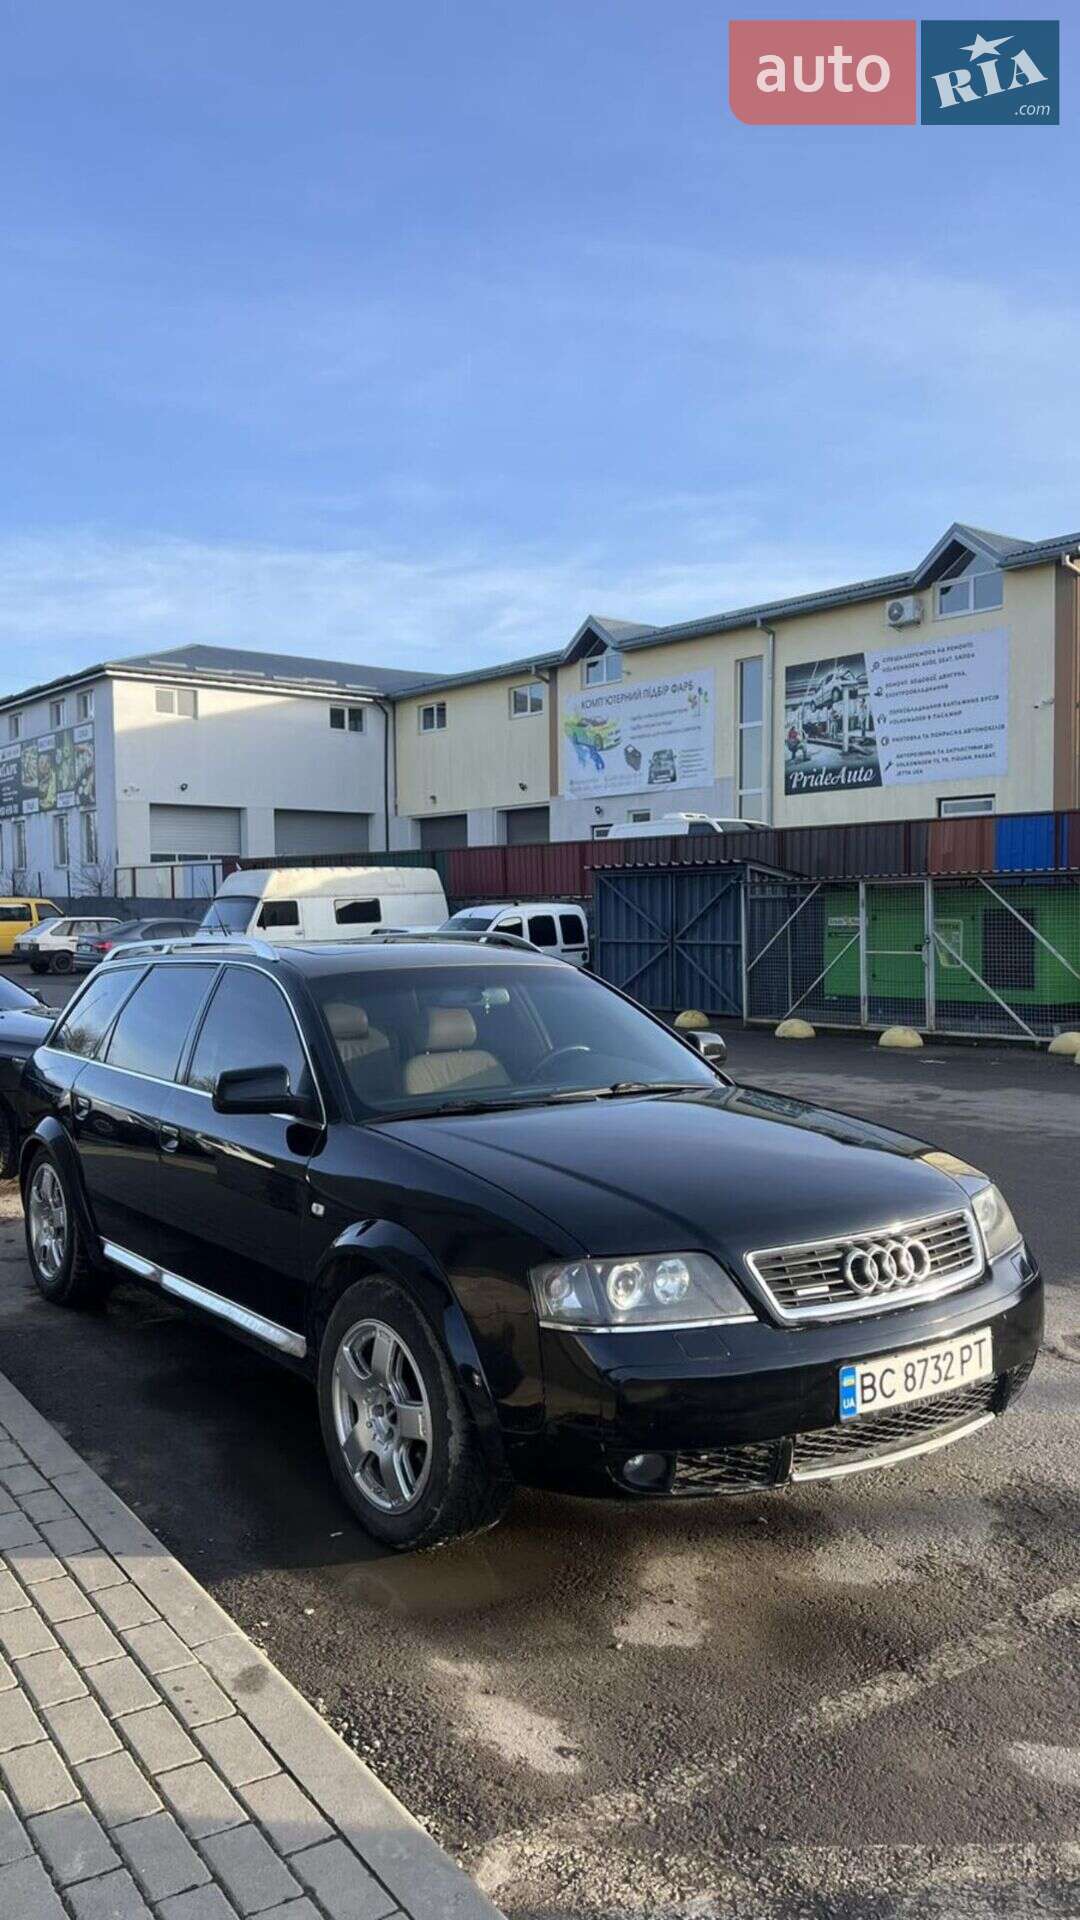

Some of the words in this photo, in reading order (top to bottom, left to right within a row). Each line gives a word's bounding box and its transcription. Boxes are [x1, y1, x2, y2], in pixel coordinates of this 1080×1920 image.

[789, 765, 876, 789] PrideAuto
[860, 1368, 896, 1404] BC
[904, 1352, 955, 1393] 8732
[960, 1338, 986, 1376] PT
[843, 1398, 855, 1409] UA
